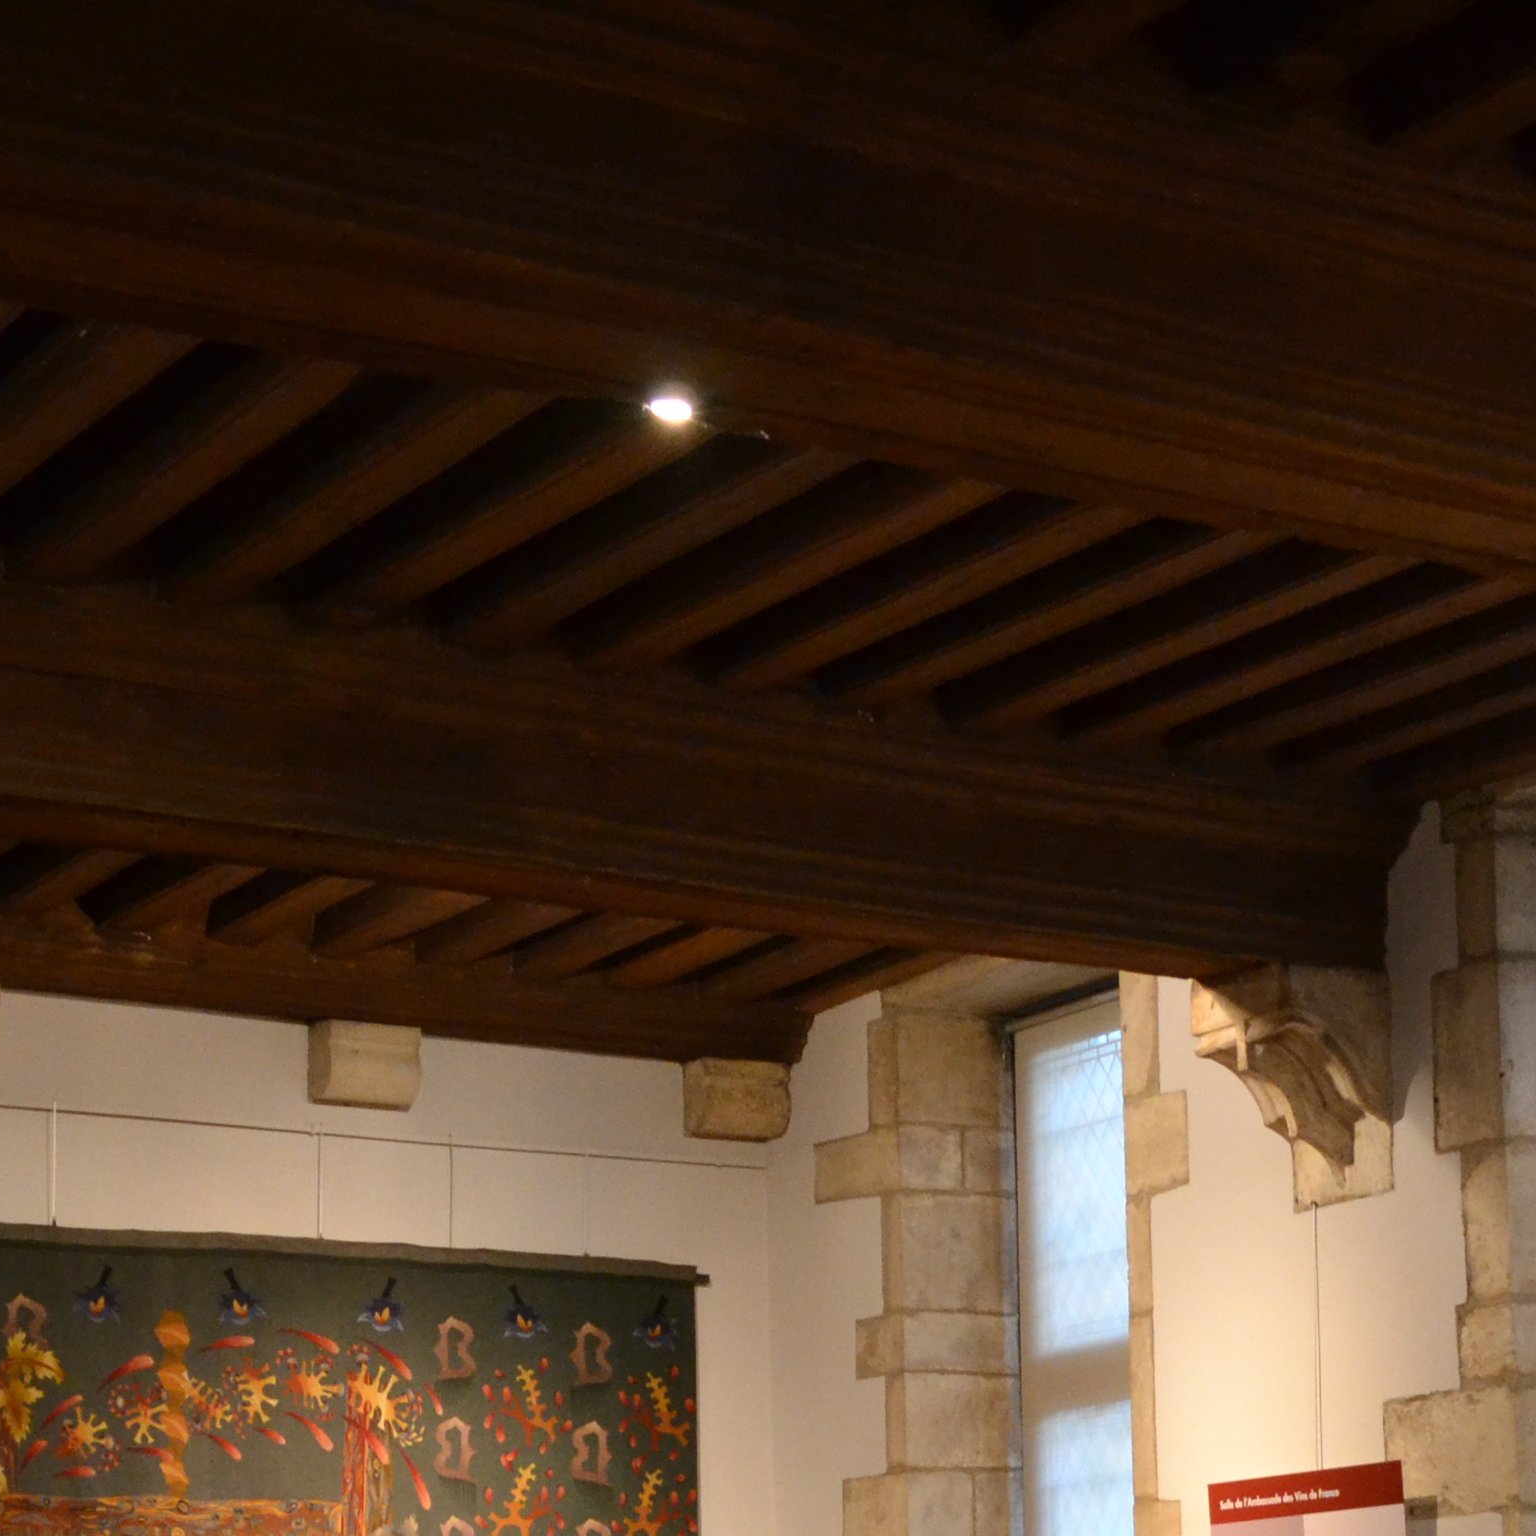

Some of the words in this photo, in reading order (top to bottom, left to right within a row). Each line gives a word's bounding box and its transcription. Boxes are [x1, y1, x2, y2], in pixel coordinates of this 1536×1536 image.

[1219, 1498, 1234, 1510] Salle
[1235, 1498, 1243, 1509] de
[1282, 1492, 1294, 1503] des
[1294, 1490, 1308, 1501] Vins
[1309, 1488, 1317, 1500] de
[1318, 1488, 1340, 1499] France
